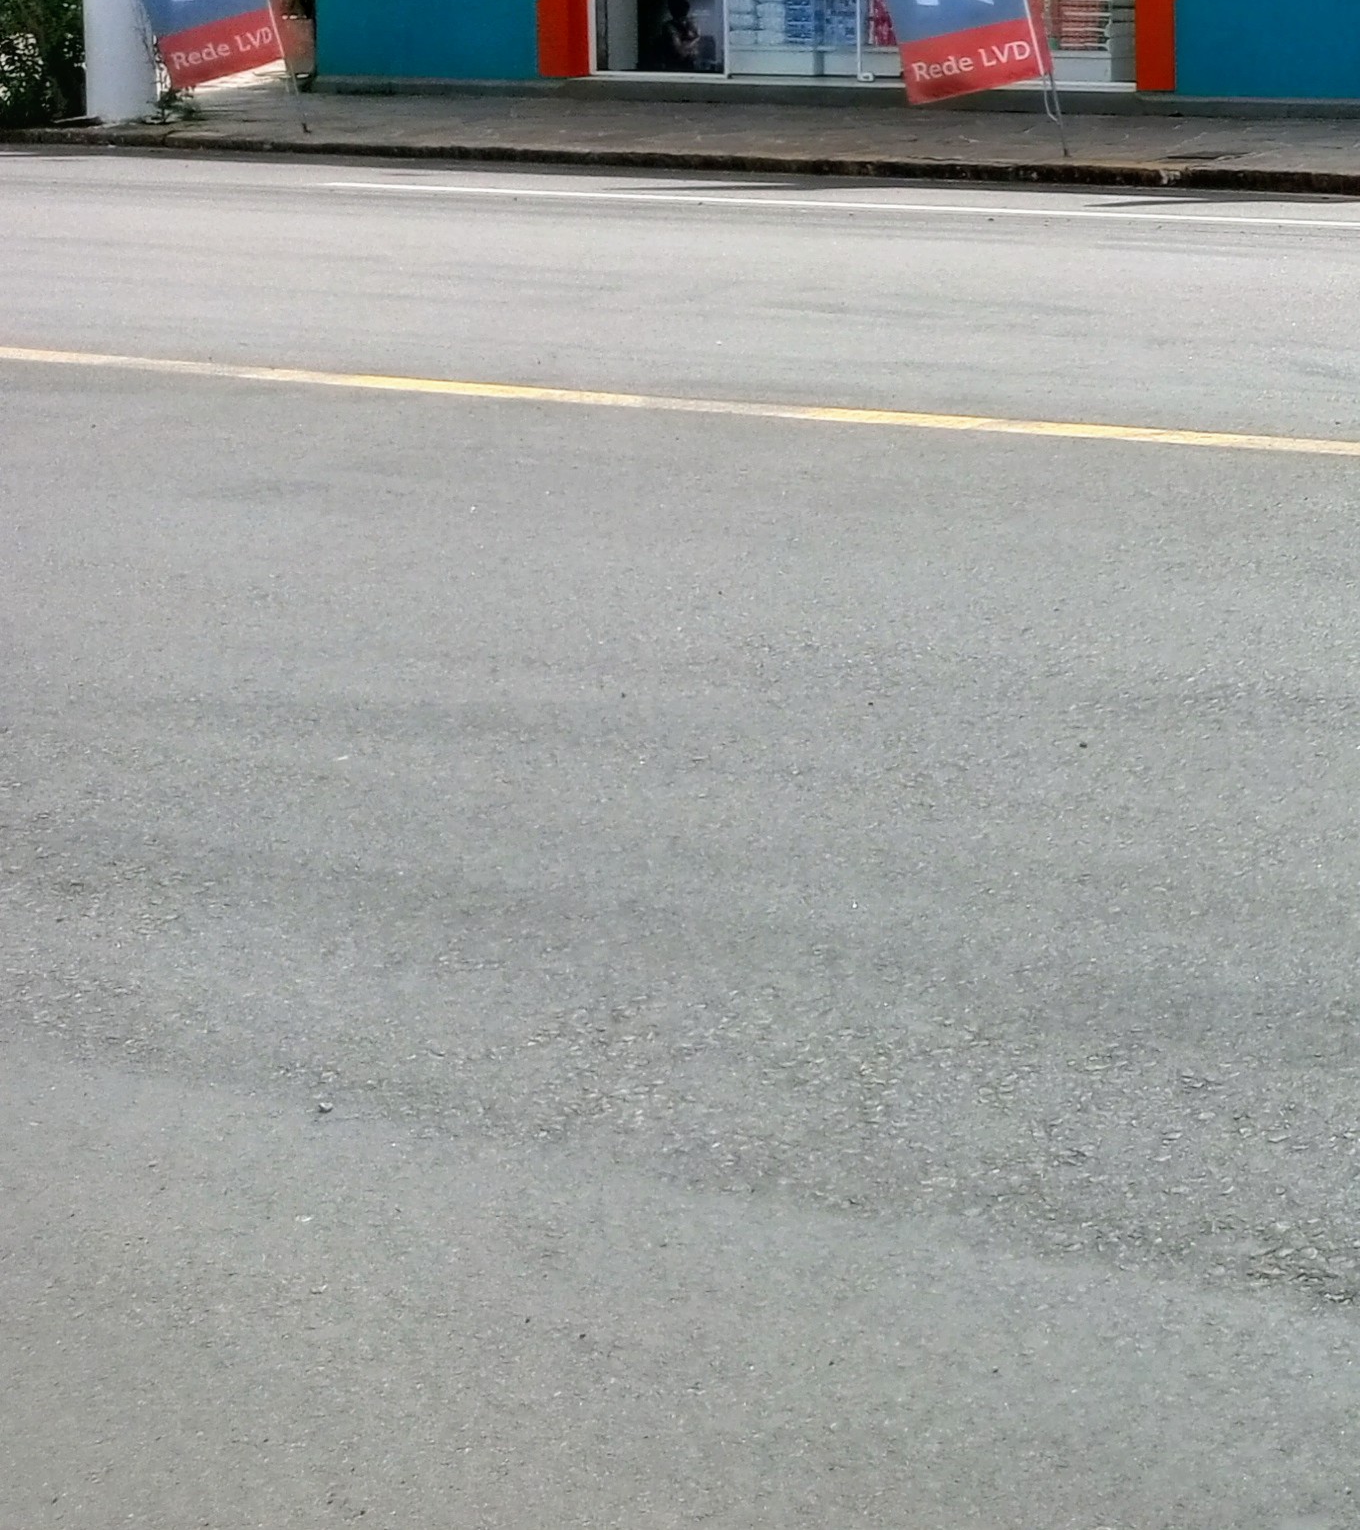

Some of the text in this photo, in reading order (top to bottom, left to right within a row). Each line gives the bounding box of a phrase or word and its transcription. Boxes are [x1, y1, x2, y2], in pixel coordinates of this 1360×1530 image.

[172, 25, 274, 70] Rede LVD
[912, 40, 1032, 82] Rede LVD
